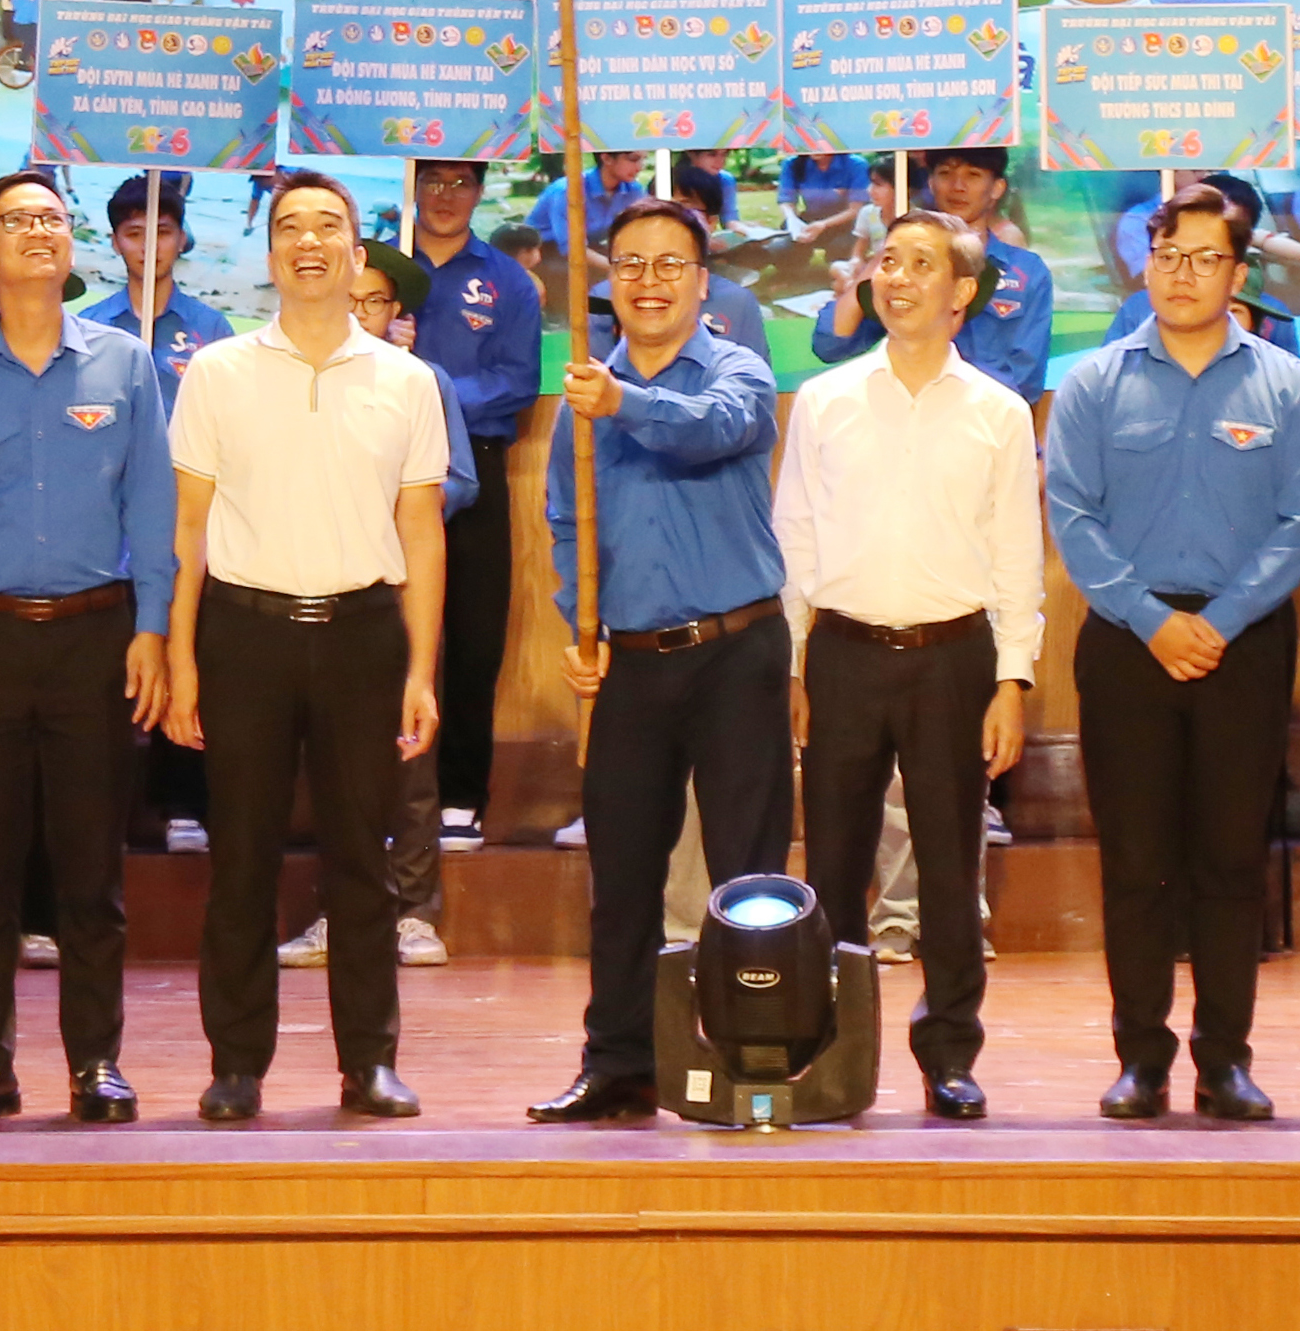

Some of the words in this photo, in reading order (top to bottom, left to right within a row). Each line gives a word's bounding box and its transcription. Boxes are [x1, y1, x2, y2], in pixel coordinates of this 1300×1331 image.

[671, 56, 697, 75] HỌC
[700, 55, 716, 74] VỤ
[830, 56, 852, 77] ĐỘI
[855, 57, 883, 73] SVTN
[933, 53, 966, 69] XANH
[77, 67, 100, 89] ĐỘI
[103, 70, 133, 86] SVTN
[185, 73, 218, 89] XANH
[222, 75, 241, 95] TẠI
[601, 86, 631, 101] STEM
[634, 86, 643, 99] &
[645, 84, 666, 100] TIN
[669, 84, 694, 102] HỌC
[697, 83, 722, 98] CHO
[748, 82, 766, 97] EM
[801, 87, 819, 106] TẠI
[841, 85, 873, 101] QUAN
[937, 81, 968, 100] LẠNG
[182, 101, 205, 116] CAO
[382, 118, 445, 147] 2026
[632, 110, 695, 139] 2026
[871, 109, 931, 138] 2026
[127, 125, 191, 156] 2026
[1139, 129, 1202, 158] 2026
[743, 973, 775, 981] BEAM
